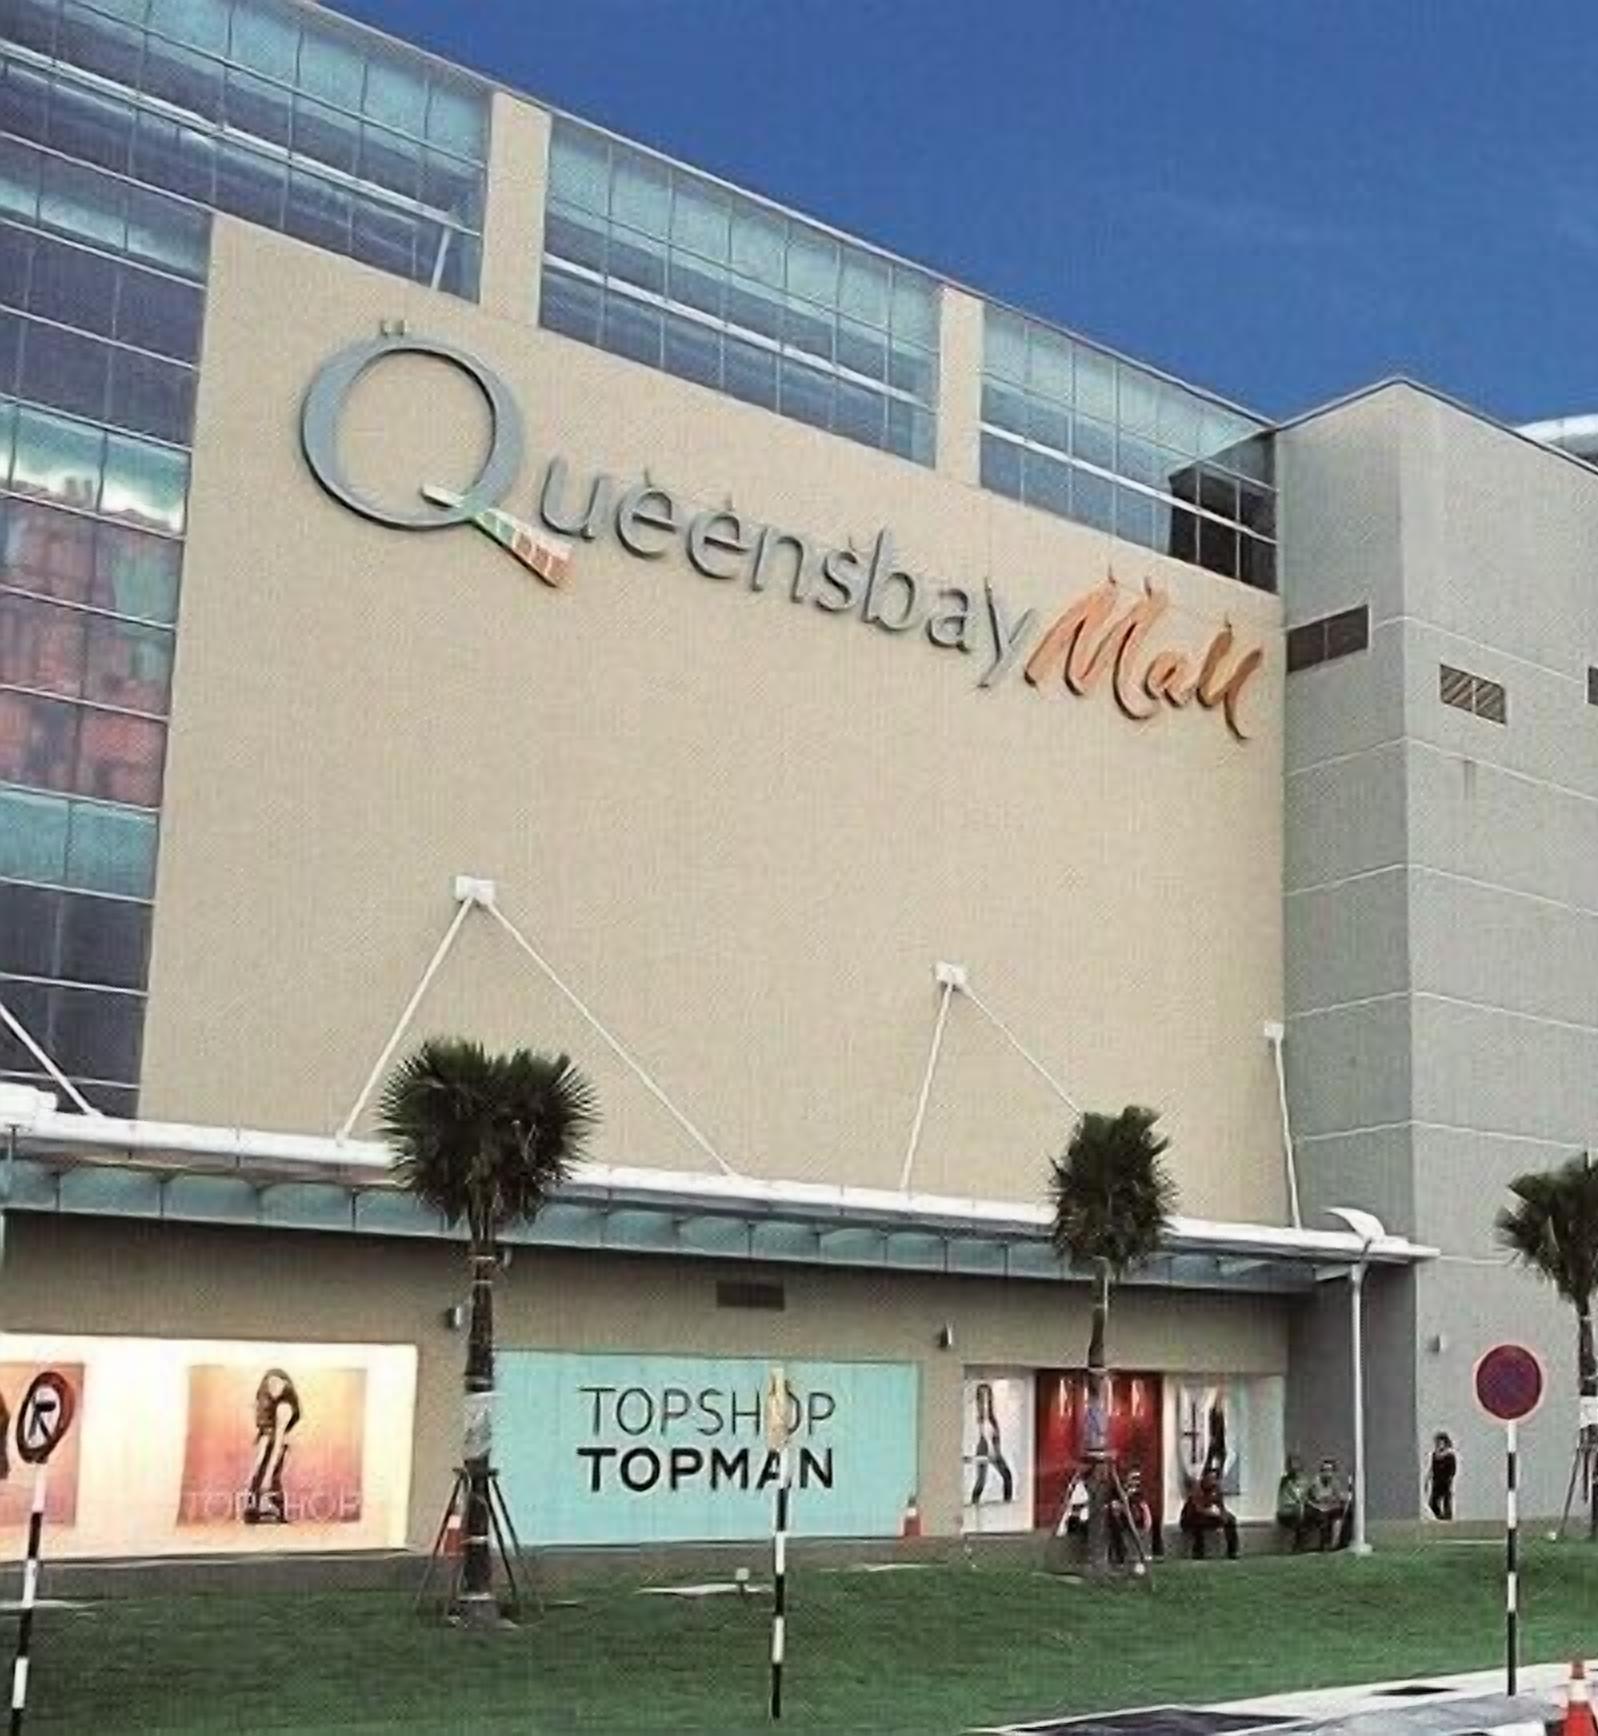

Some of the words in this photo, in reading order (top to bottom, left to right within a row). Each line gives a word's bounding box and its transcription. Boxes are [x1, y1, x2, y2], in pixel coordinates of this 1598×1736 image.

[300, 334, 1036, 690] Queensbay
[1023, 577, 1264, 740] Mall
[578, 1386, 836, 1436] TOPSHOP
[576, 1447, 834, 1492] TOPMAN
